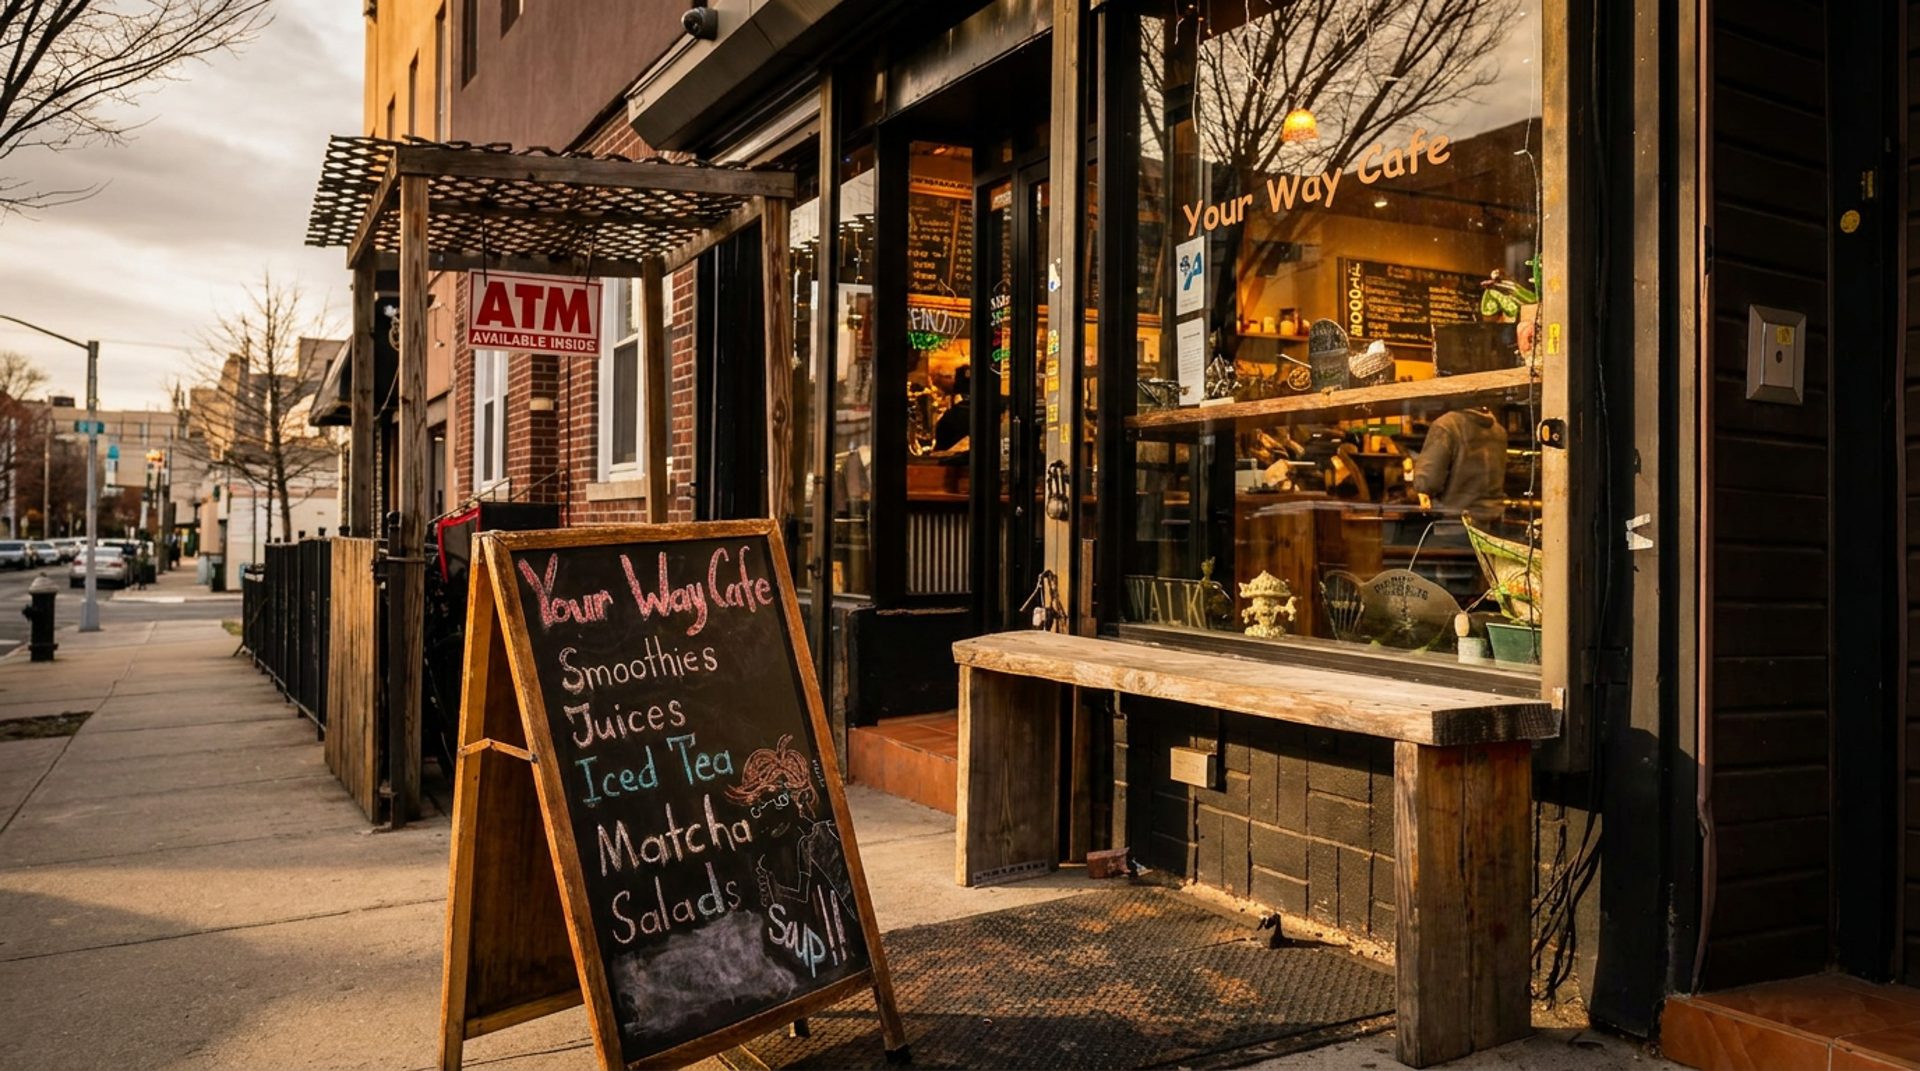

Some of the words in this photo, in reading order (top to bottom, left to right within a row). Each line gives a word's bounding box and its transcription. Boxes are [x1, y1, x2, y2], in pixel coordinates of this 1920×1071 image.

[1183, 194, 1253, 236] Your
[1266, 167, 1342, 213] Way
[1357, 128, 1450, 184] Cafe
[472, 331, 547, 348] AVAILABLE
[551, 337, 596, 351] INSIDE
[476, 281, 591, 334] ATM
[518, 553, 613, 627] Your
[620, 552, 709, 636] Way
[708, 546, 774, 613] Cafe
[559, 635, 718, 694] Smoothies
[563, 700, 687, 749] Juices
[575, 745, 658, 804] Iced
[666, 733, 734, 785] Tea
[597, 794, 752, 877] Matcha
[611, 861, 741, 944] Salads
